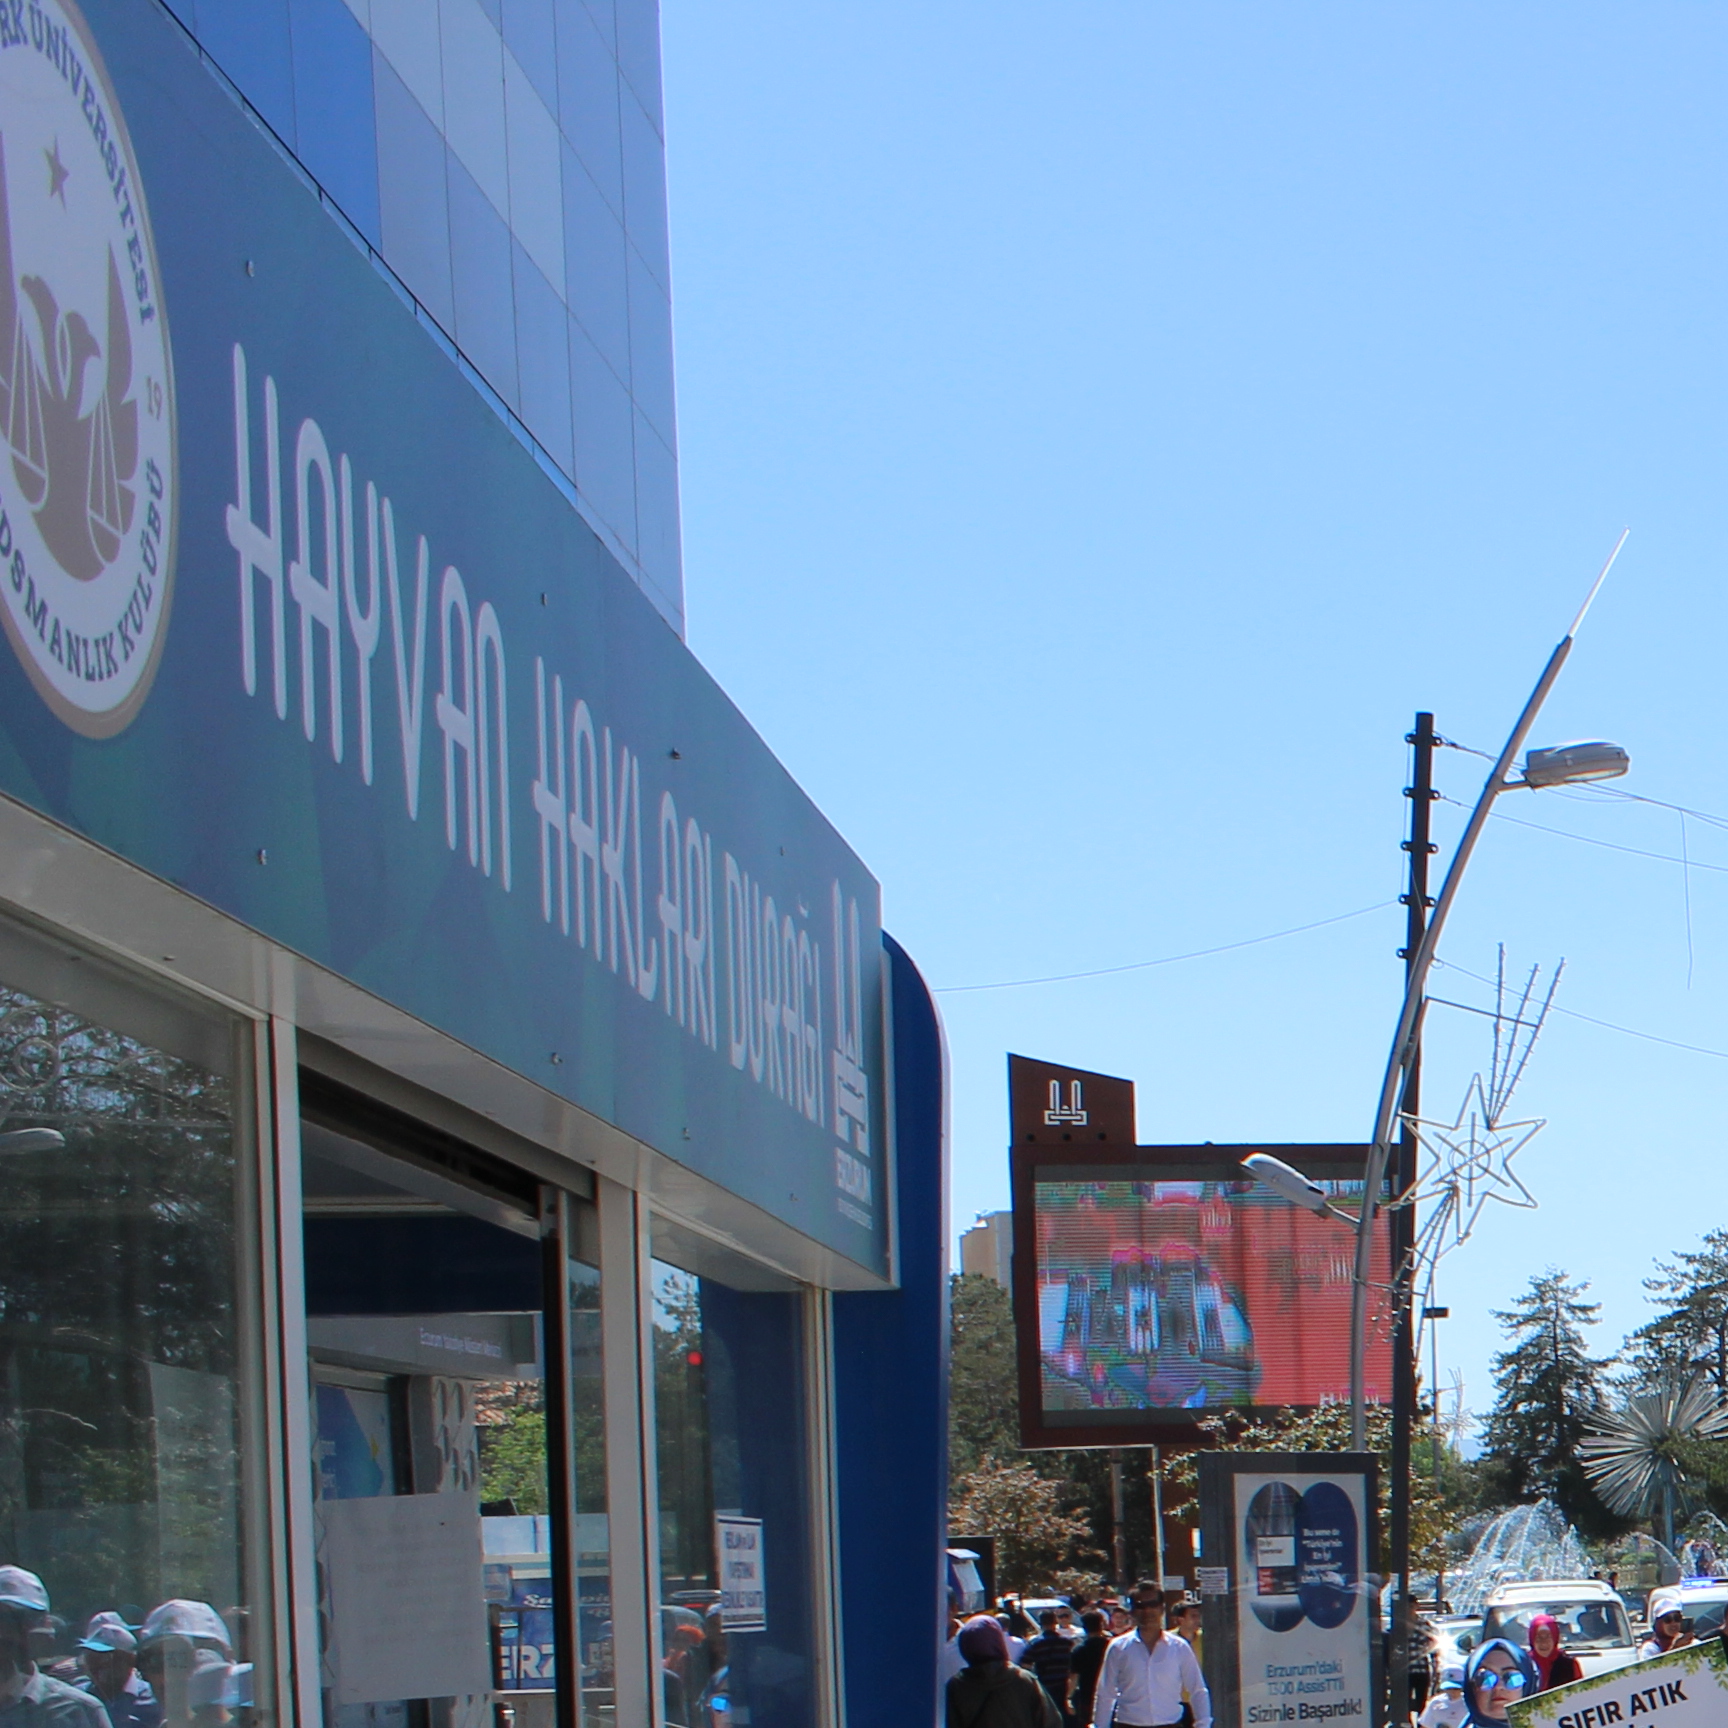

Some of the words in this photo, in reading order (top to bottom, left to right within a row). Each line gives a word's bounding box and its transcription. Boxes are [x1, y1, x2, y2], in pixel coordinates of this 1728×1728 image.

[117, 457, 164, 663] KULÜBÜ
[226, 342, 512, 893] HAYVAN
[532, 656, 717, 1051] HAKLARI
[725, 850, 826, 1129] DURAĞI
[1266, 1659, 1343, 1678] Erzurum'daki
[1248, 1702, 1296, 1723] Sizinle
[1298, 1698, 1362, 1723] Başardık!
[1630, 1679, 1688, 1717] ATIK
